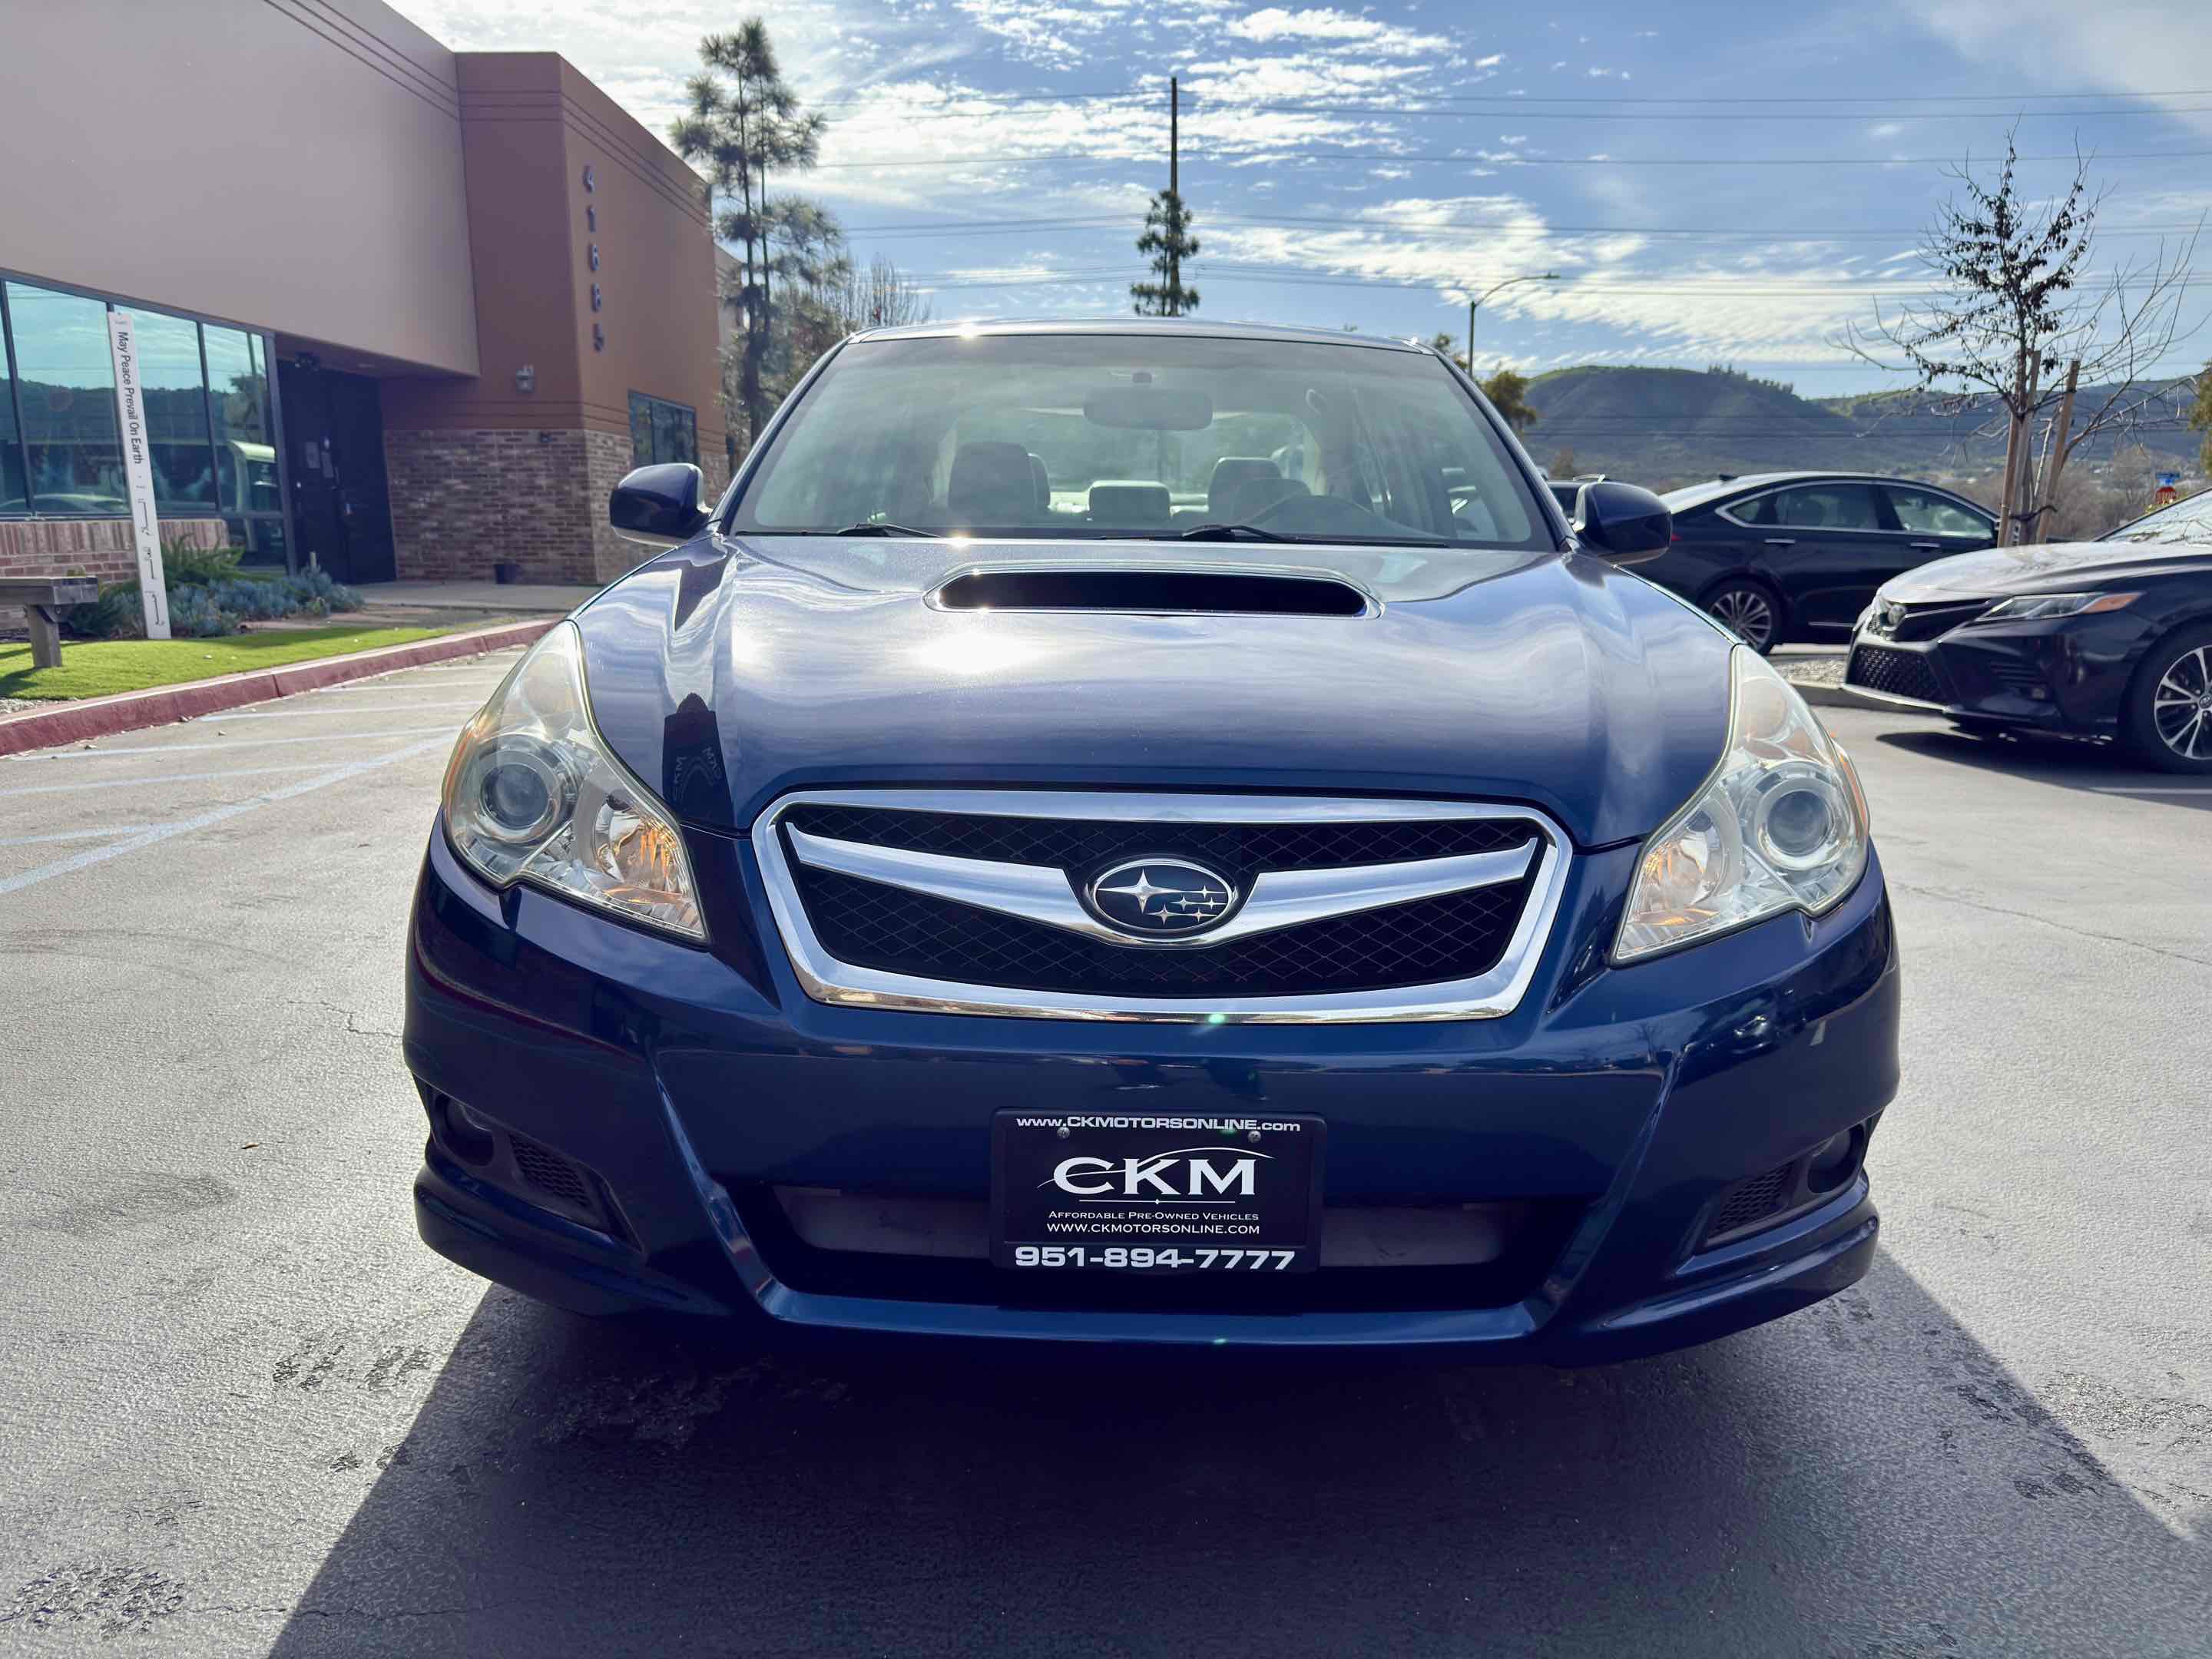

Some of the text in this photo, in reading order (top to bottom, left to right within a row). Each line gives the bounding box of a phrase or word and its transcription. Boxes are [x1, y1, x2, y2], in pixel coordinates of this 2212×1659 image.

[118, 331, 129, 354] May
[122, 355, 131, 385] Peace
[124, 388, 137, 420] Prevail
[130, 422, 141, 436] On
[131, 437, 142, 465] Earth
[1016, 1117, 1300, 1131] www.CKMOTORSONLINE.com
[1053, 1157, 1256, 1196] CKM
[1047, 1224, 1260, 1234] WWW.CKMOTORSONLINE.COM
[1015, 1247, 1295, 1270] 951-894-7777
